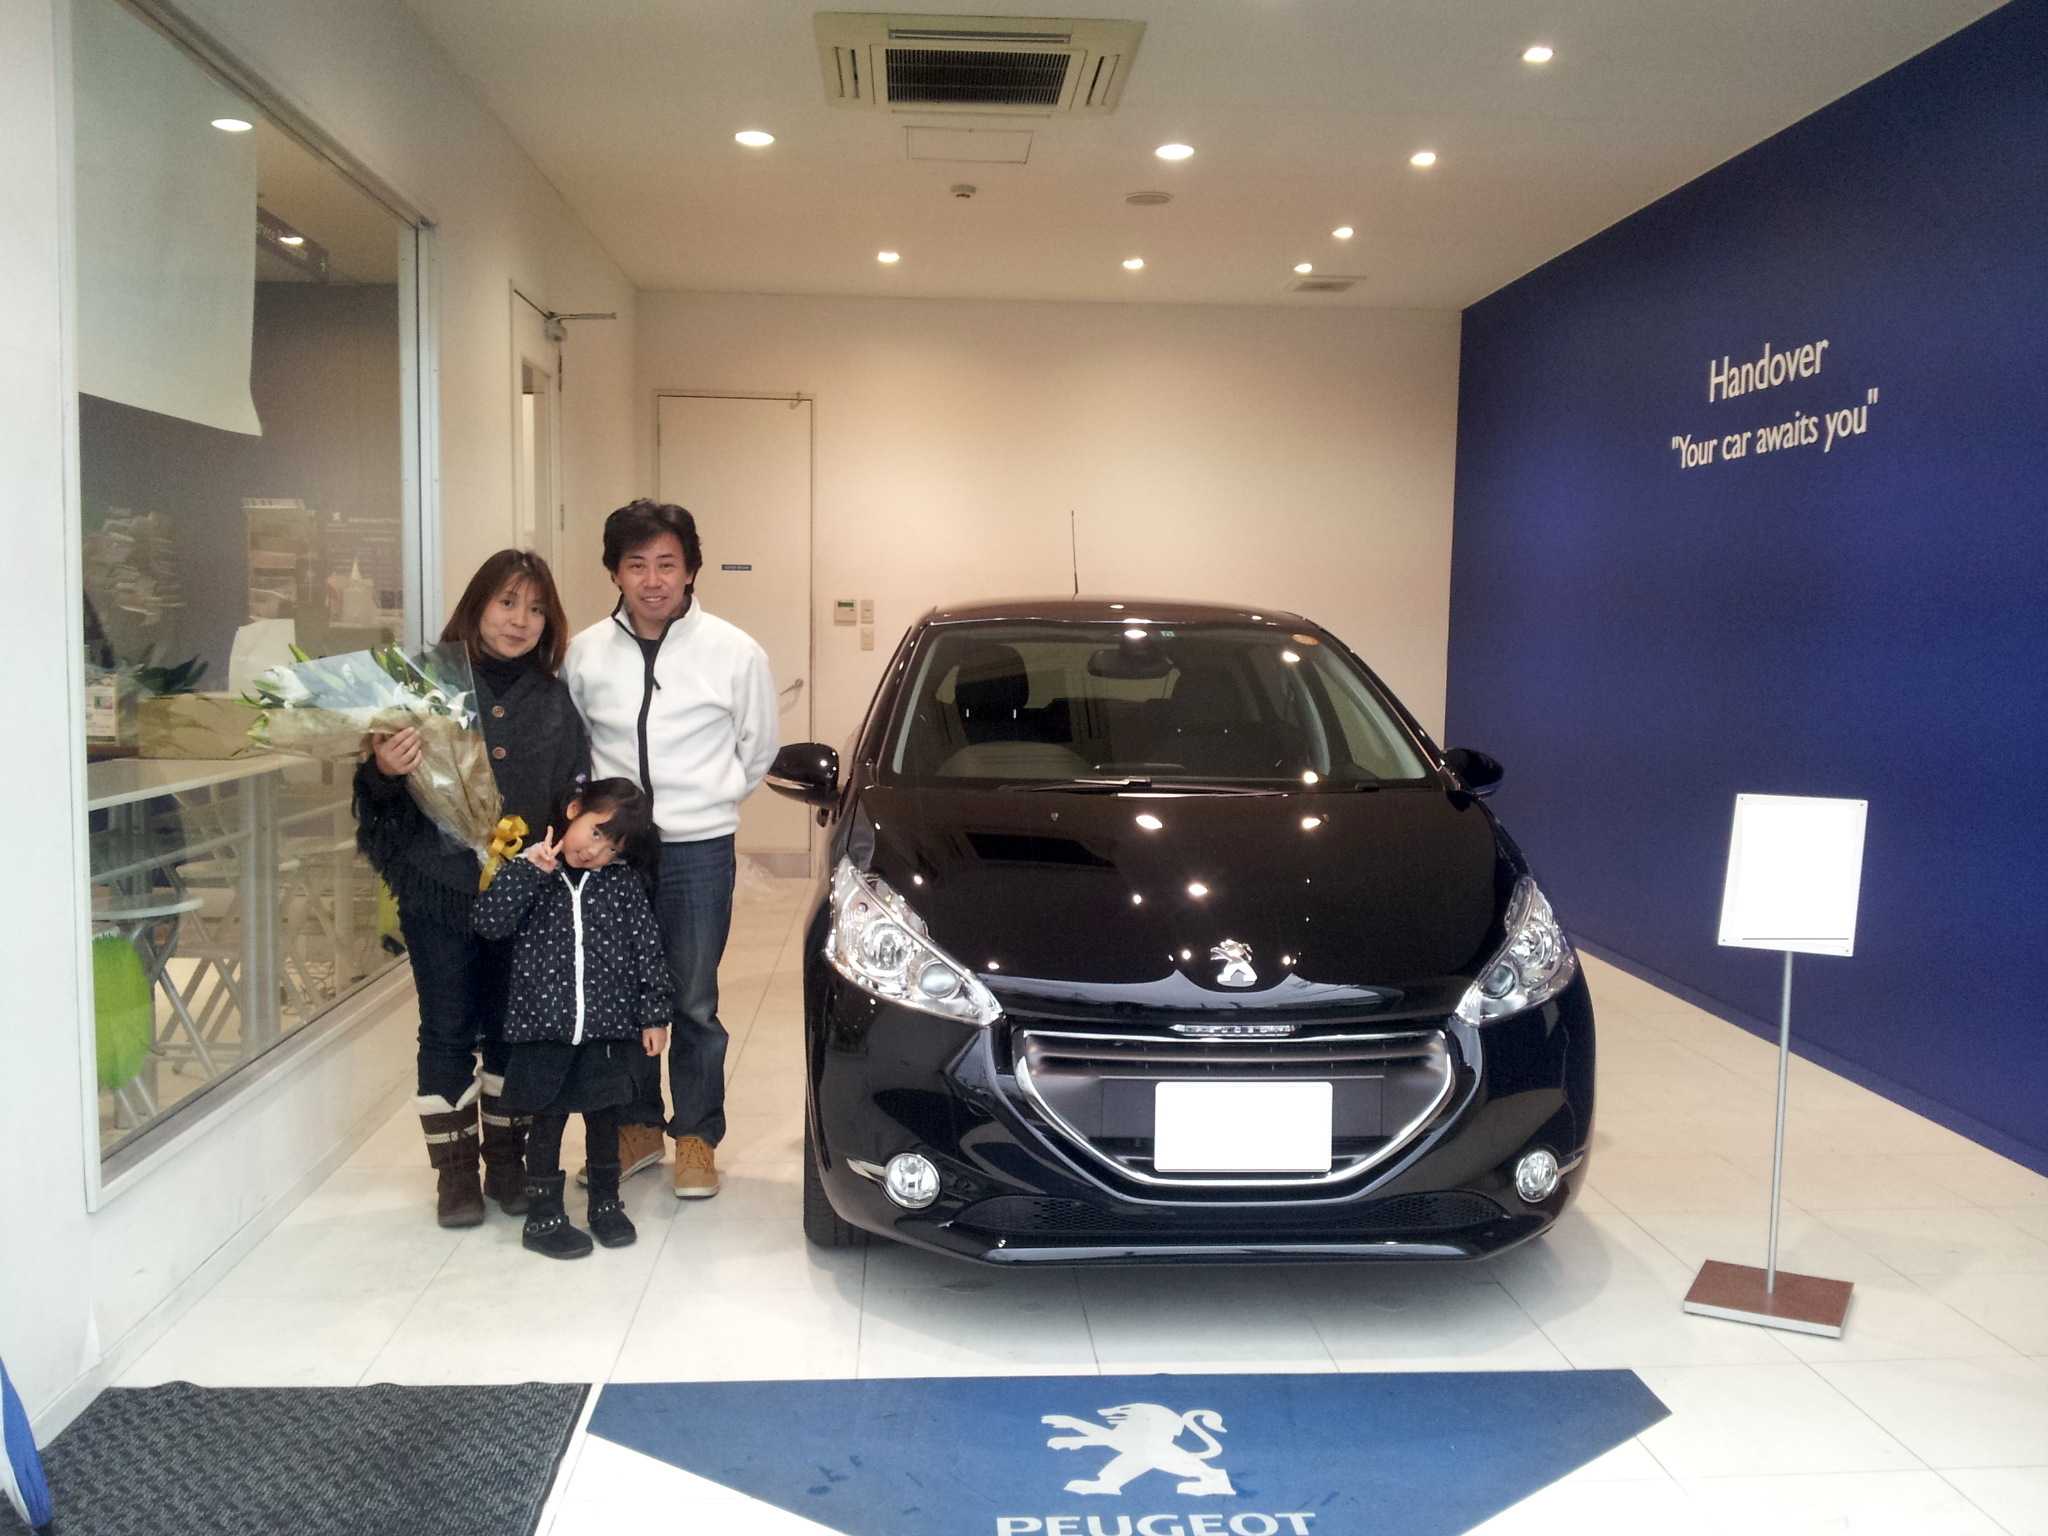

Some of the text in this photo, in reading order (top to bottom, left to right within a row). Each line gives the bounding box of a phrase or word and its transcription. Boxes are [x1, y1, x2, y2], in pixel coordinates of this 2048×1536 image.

[1709, 339, 1829, 403] Handover
[1671, 387, 1879, 469] "Your car awaits you"
[996, 1512, 1316, 1536] PEUGEOT
